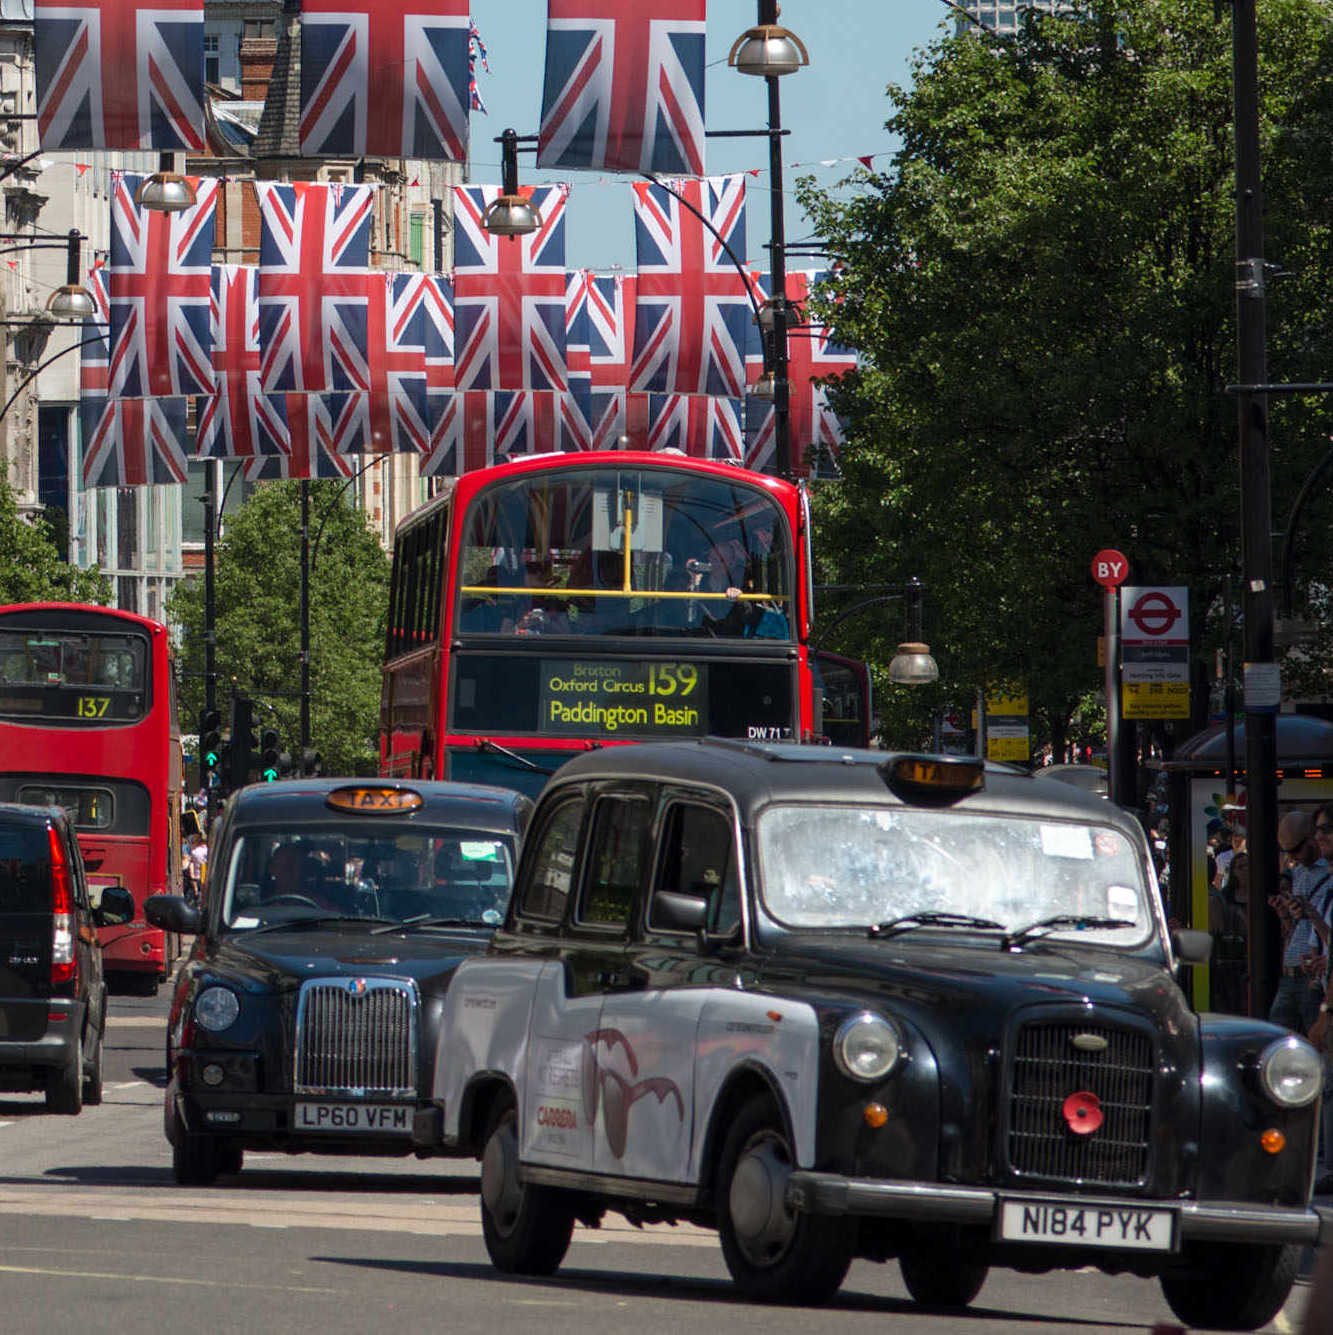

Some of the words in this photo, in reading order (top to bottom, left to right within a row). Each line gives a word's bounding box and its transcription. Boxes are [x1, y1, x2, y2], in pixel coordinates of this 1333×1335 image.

[1098, 562, 1122, 578] BY
[573, 664, 621, 677] Brixton
[648, 662, 697, 696] 159
[549, 677, 598, 692] Oxford
[603, 679, 645, 693] Circus
[77, 698, 111, 718] 137
[550, 700, 648, 731] Paddington
[654, 703, 699, 726] Basin
[748, 726, 767, 739] DW
[768, 727, 781, 739] 71
[347, 792, 404, 807] TAXI
[302, 1106, 359, 1127] LP60
[365, 1108, 407, 1128] VFM
[537, 1106, 578, 1129] CARRERA
[1022, 1206, 1087, 1237] N184
[1096, 1210, 1154, 1242] PYK
